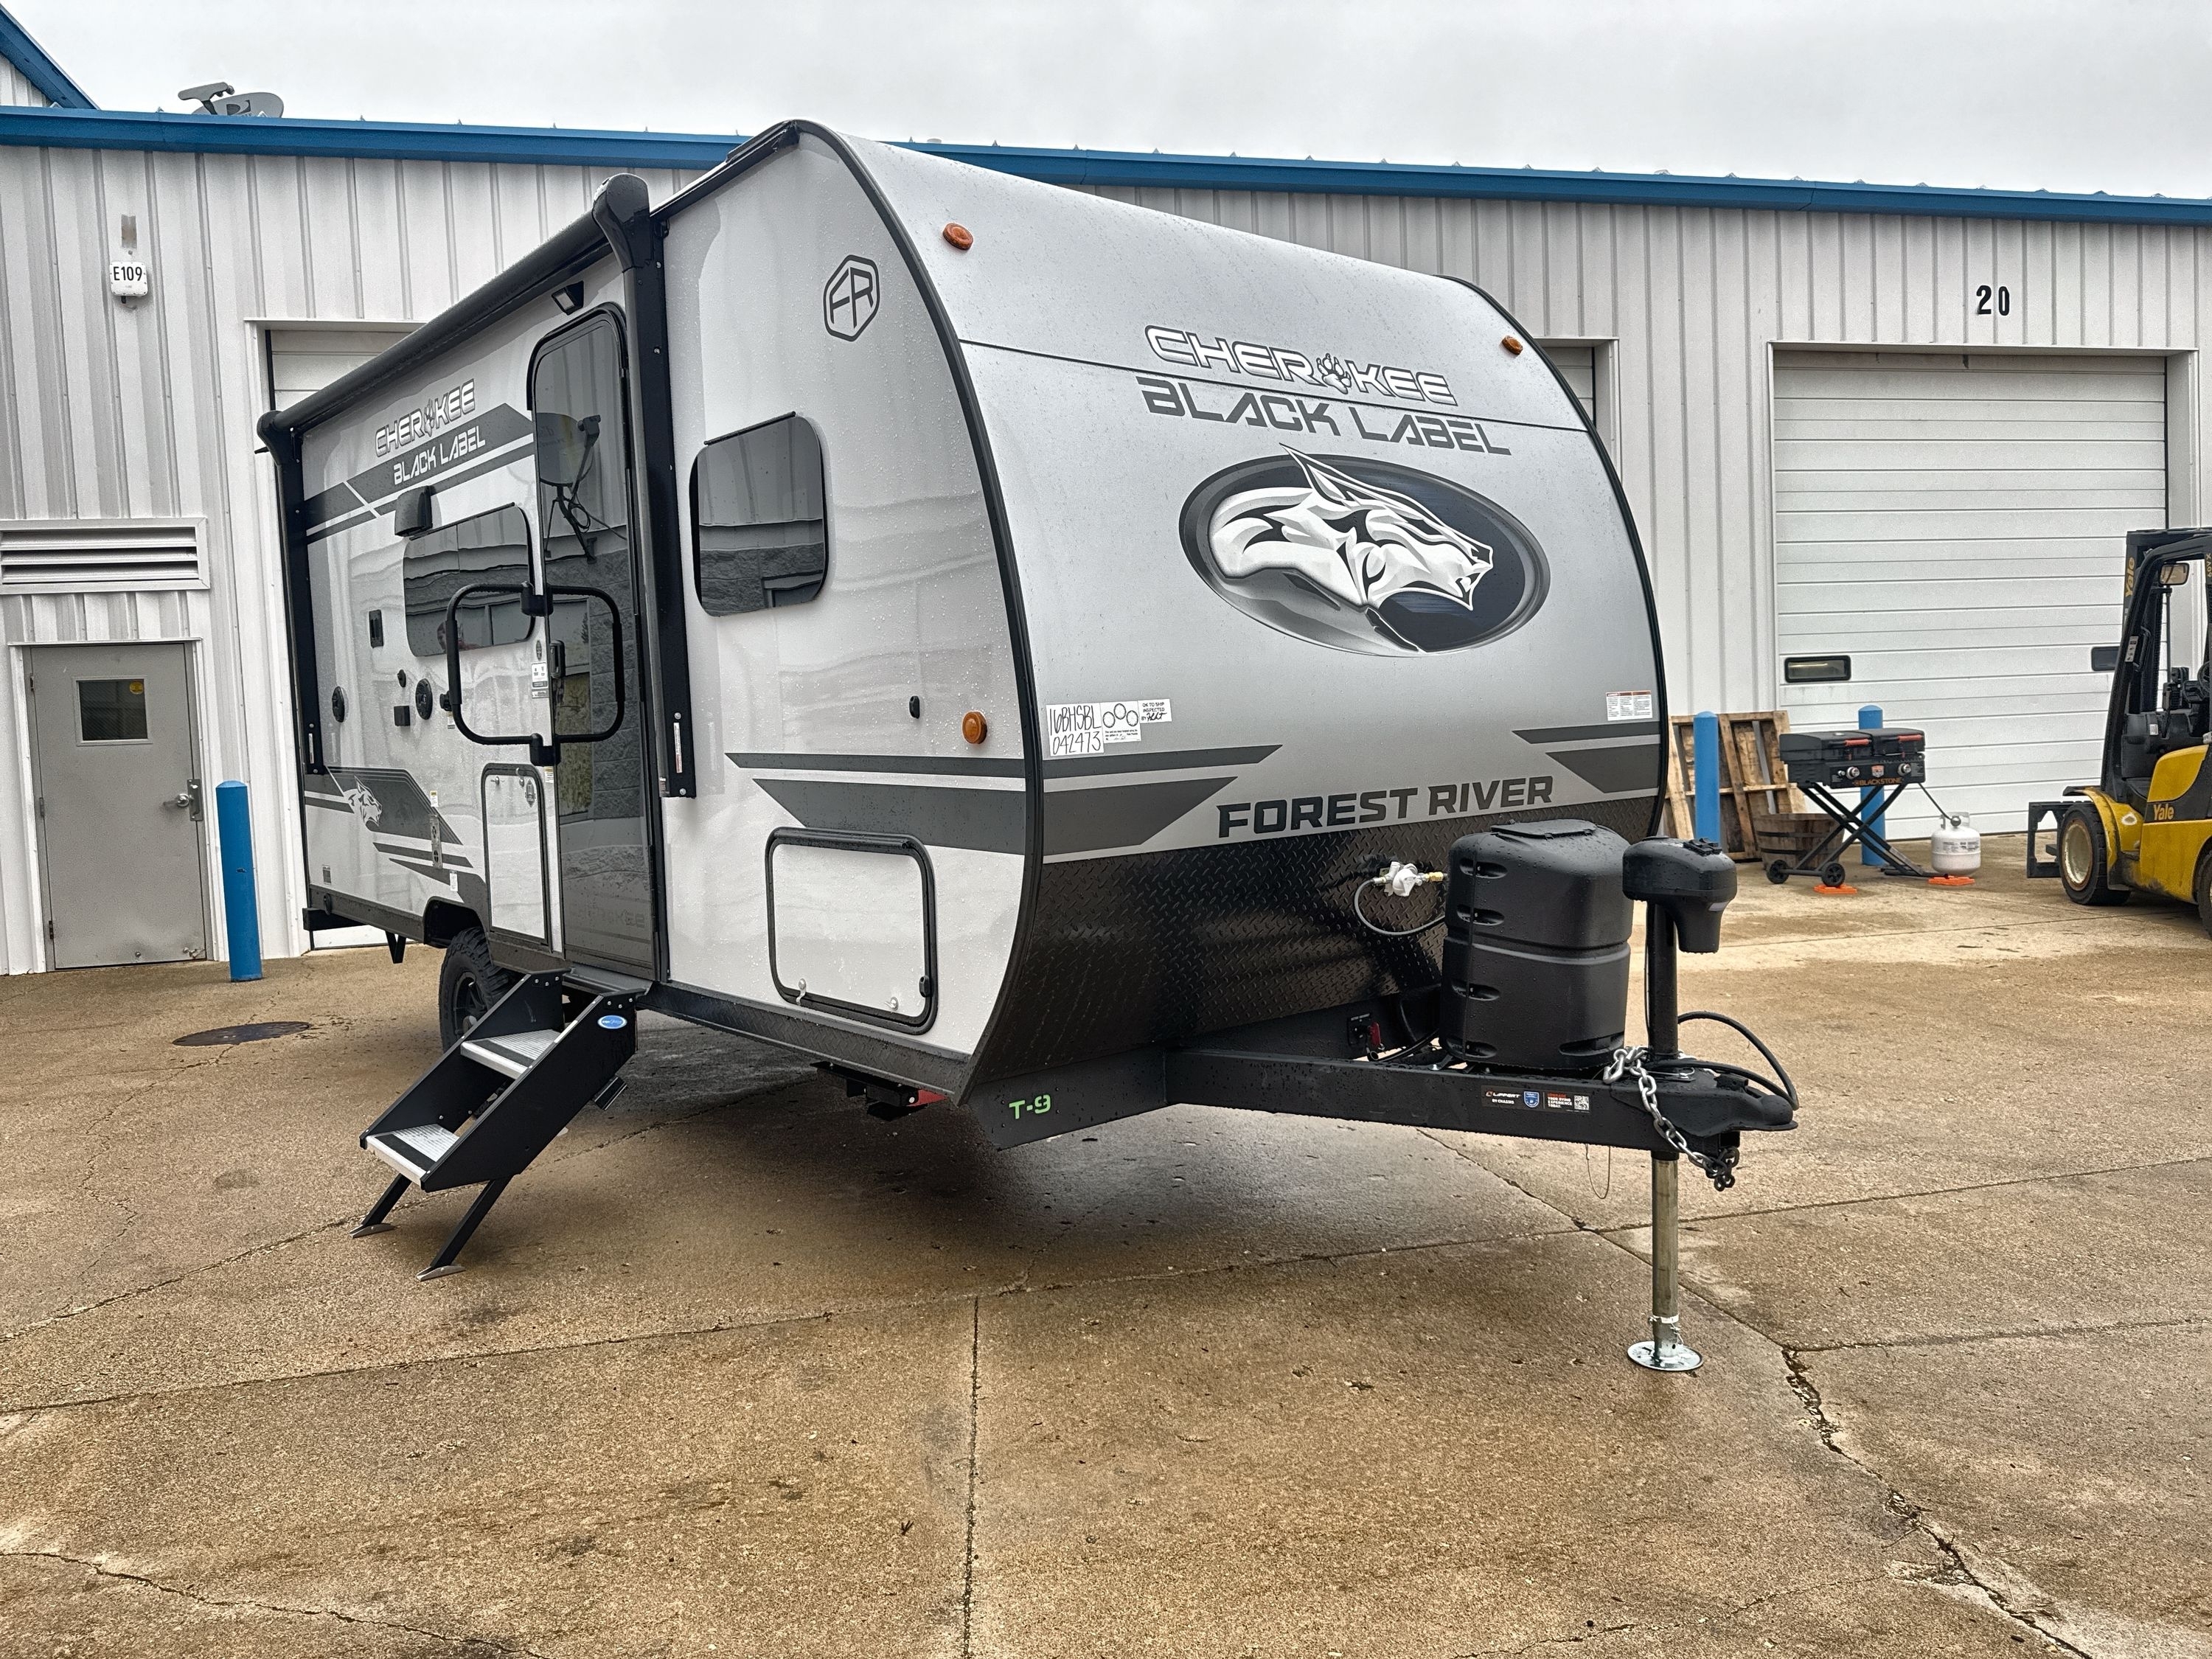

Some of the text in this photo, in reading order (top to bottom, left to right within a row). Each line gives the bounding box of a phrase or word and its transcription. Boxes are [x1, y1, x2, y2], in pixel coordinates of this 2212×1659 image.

[114, 266, 142, 281] E109
[1976, 285, 2010, 316] 20
[1135, 376, 1512, 456] BLACK LABEL
[394, 425, 486, 485] BLACK LABEL
[2125, 557, 2135, 598] Yale
[1050, 705, 1102, 736] 16BHSBL
[1053, 731, 1102, 755] 042473
[1859, 777, 1903, 786] BLACKSTONE
[1216, 776, 1554, 838] FOREST RIVER
[2153, 803, 2174, 821] Yale
[1009, 1094, 1051, 1119] T-9
